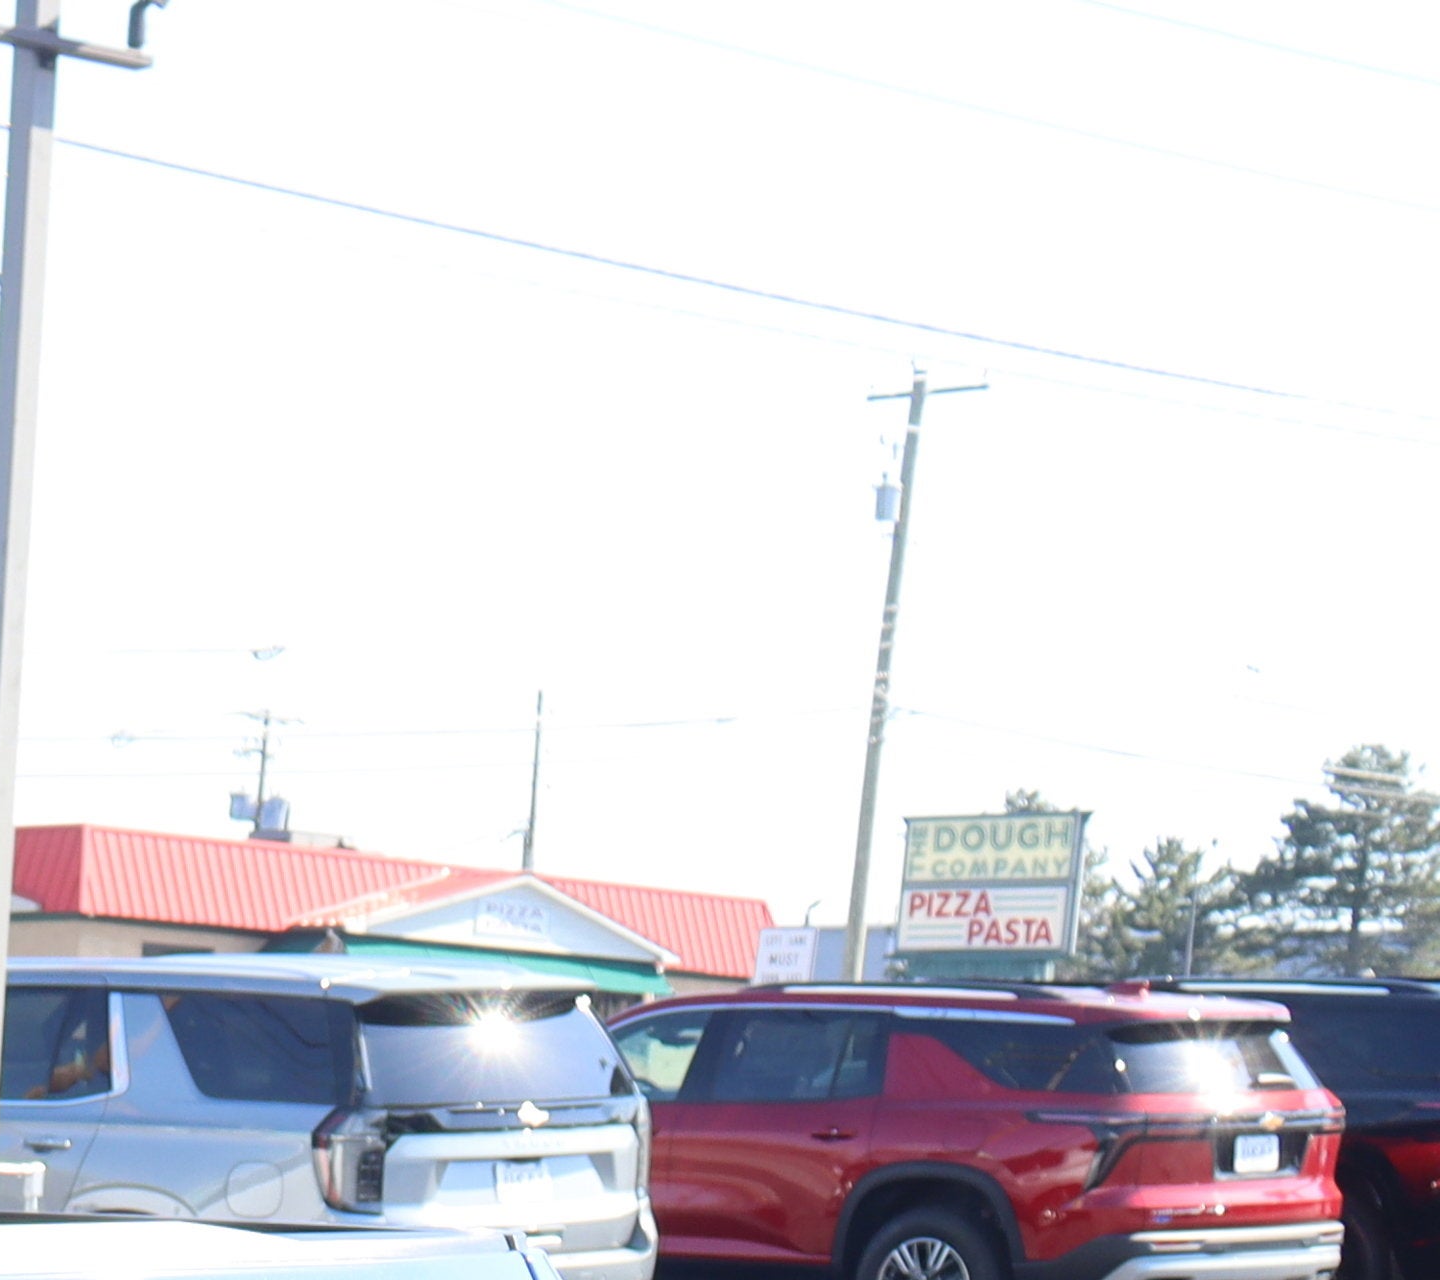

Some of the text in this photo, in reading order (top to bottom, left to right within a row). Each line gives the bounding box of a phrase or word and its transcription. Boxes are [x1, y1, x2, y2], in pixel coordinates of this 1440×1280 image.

[910, 825, 929, 877] THE
[933, 821, 1070, 853] DOUGH
[931, 857, 1069, 879] COMPANY
[908, 890, 992, 918] PIZZA
[967, 918, 1053, 946] PASTA
